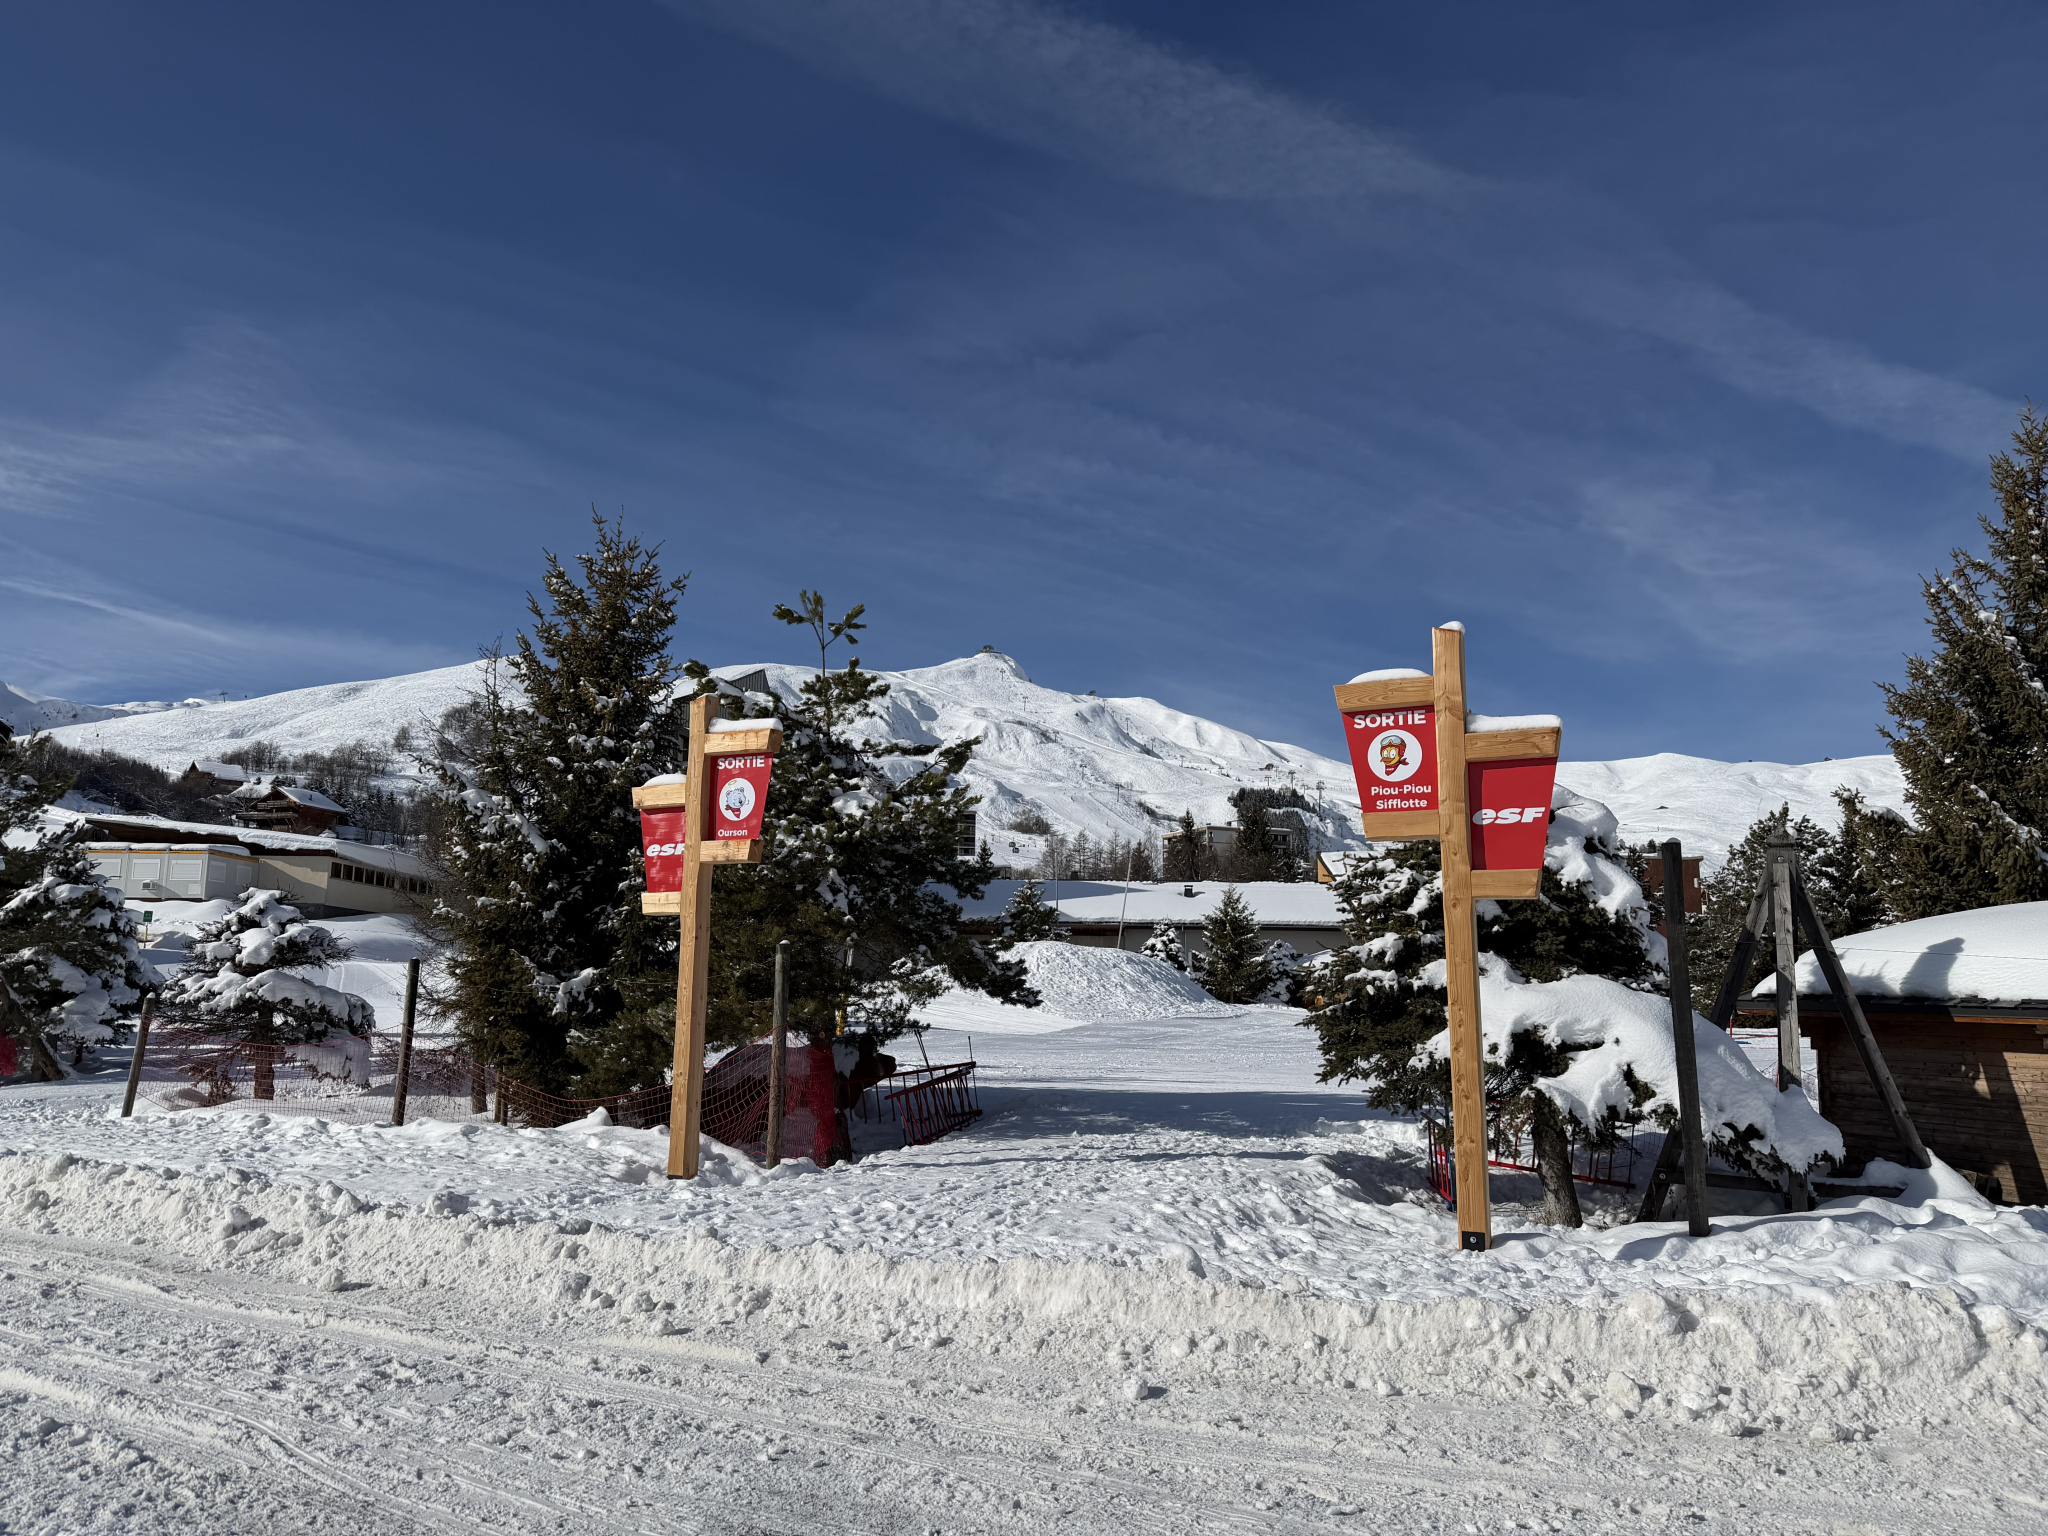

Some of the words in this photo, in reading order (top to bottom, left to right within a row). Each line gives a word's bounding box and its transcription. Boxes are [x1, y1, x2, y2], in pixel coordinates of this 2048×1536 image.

[1353, 709, 1427, 730] SORTIE
[717, 755, 765, 771] SORTIE
[1371, 783, 1432, 796] Piou-Piou
[1376, 798, 1428, 811] Sifflotte
[717, 828, 748, 838] Ourson
